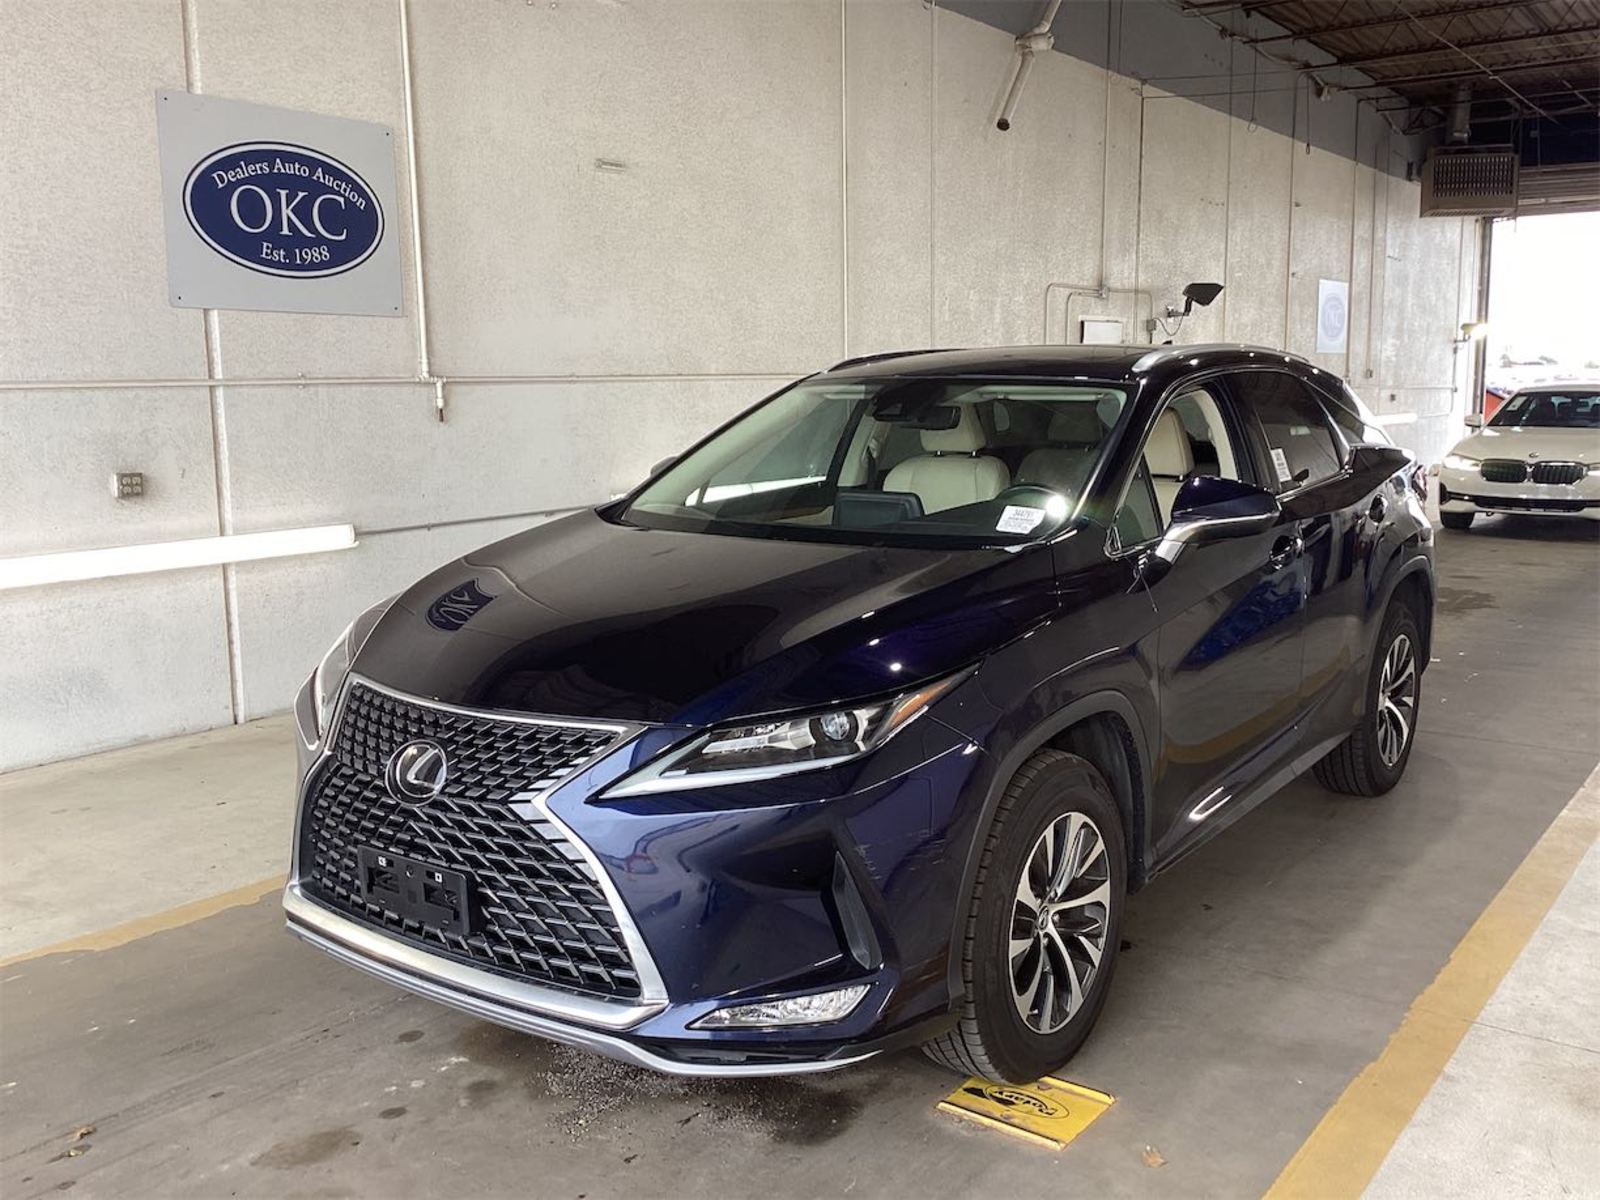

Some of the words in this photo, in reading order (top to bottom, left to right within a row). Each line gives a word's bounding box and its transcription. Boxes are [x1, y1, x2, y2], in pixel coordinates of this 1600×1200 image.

[212, 161, 269, 189] Dealers
[273, 158, 309, 177] Auto
[312, 167, 367, 210] Auction
[230, 184, 347, 241] OKC
[260, 242, 290, 263] Est.
[294, 246, 330, 264] 1988
